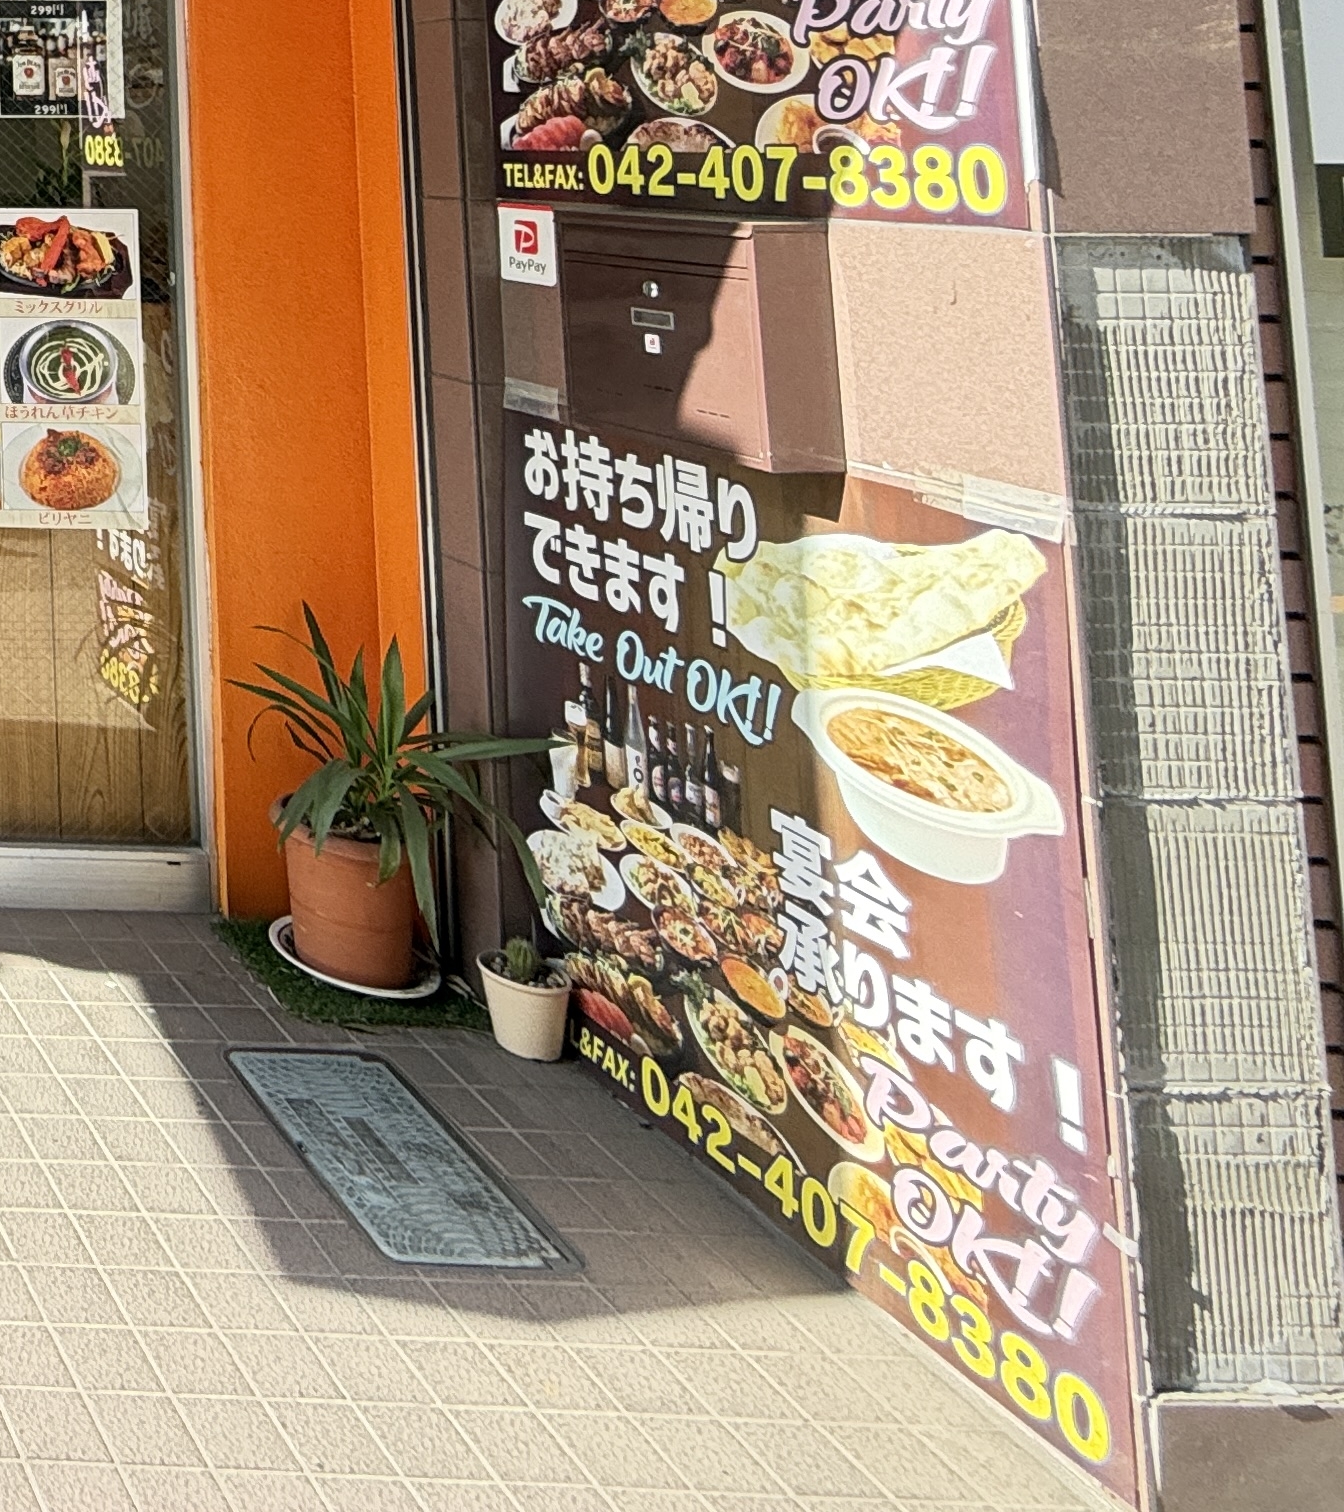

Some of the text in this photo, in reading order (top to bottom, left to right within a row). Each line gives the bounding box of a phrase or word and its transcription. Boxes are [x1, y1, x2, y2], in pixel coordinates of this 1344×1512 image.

[502, 143, 1007, 214] TEL&FAX: 042-407-8380
[14, 299, 103, 314] ミックスグリル
[508, 256, 546, 275] PayPay
[5, 405, 118, 420] ほうれん草チキン
[523, 429, 759, 562] お持ち帰り
[521, 595, 604, 663] Take
[615, 628, 681, 694] Out
[770, 806, 913, 962] 宴会
[863, 1055, 1098, 1265] Party
[641, 1055, 1111, 1465] 042-407-8380
